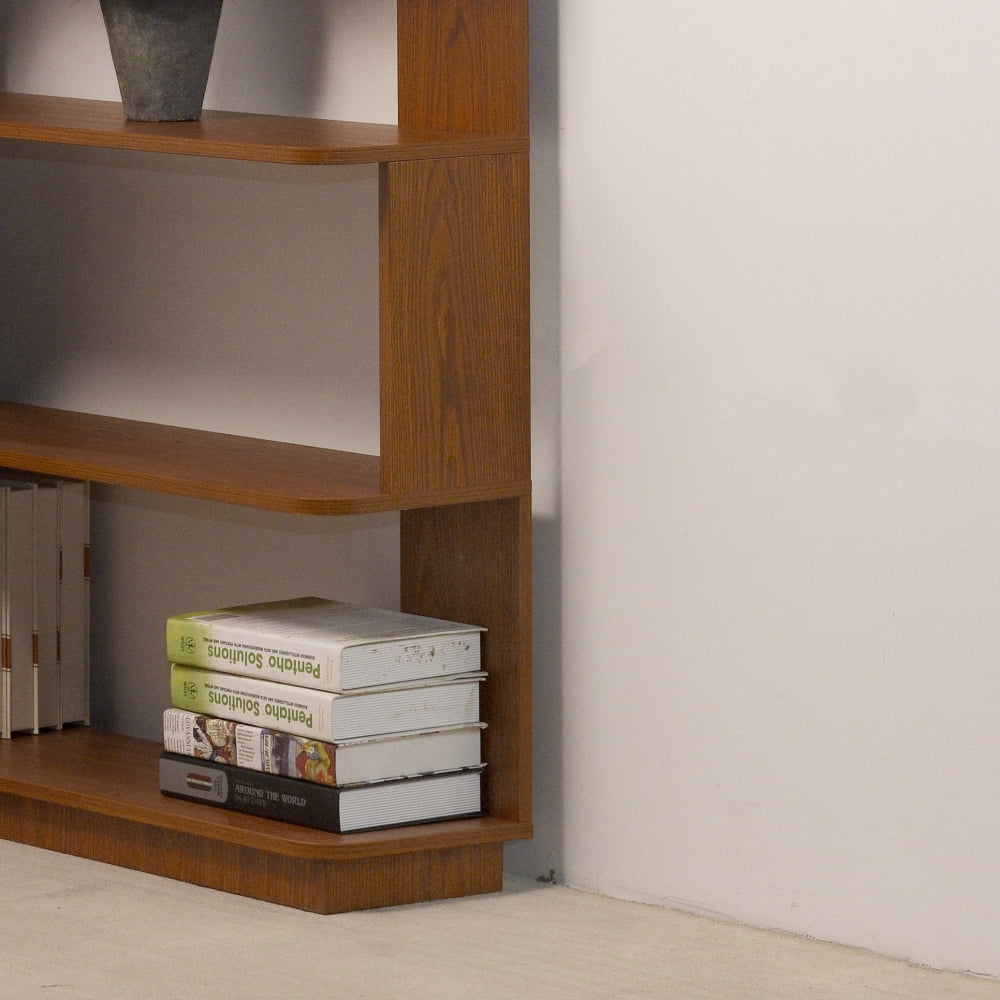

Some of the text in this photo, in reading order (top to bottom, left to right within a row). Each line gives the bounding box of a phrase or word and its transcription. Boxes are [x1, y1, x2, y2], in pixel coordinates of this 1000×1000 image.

[207, 645, 263, 669] Solutions
[268, 656, 321, 679] Pentaho
[208, 691, 260, 717] Solutions
[264, 704, 313, 729] Pentaho
[235, 784, 265, 796] AROUND
[266, 791, 279, 801] THE
[281, 793, 306, 807] WORLD
